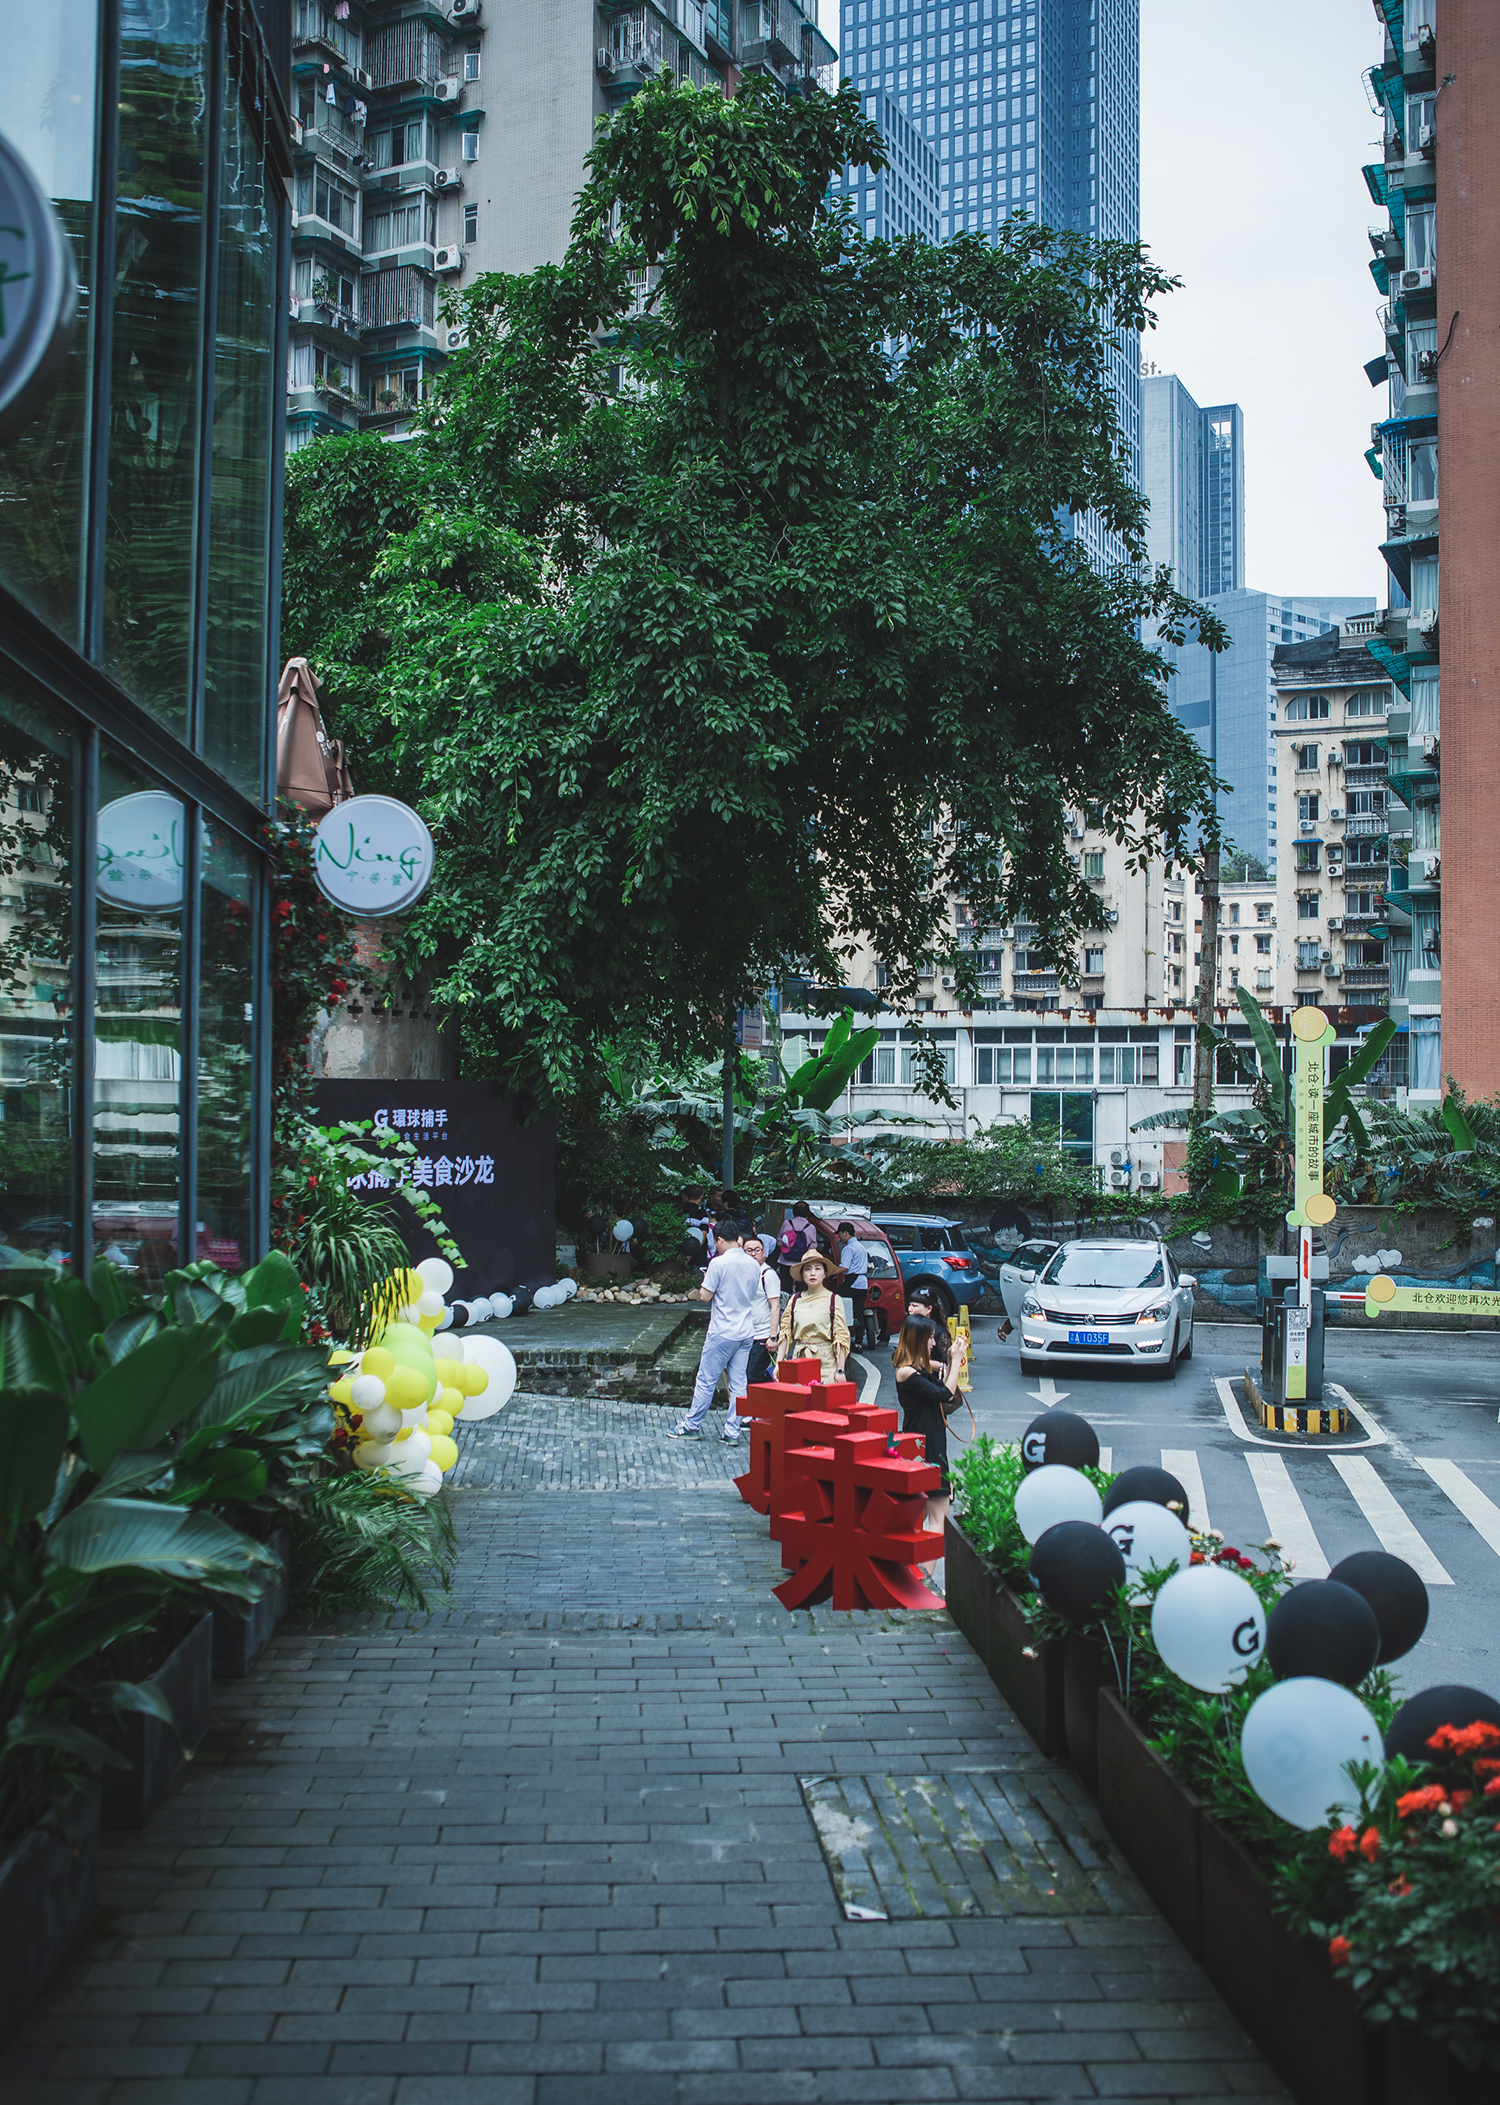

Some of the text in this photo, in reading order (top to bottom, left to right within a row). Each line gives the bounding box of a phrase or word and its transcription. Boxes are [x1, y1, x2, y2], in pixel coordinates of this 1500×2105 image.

[318, 822, 422, 881] Ning
[374, 1109, 448, 1128] G 環球捕手
[1023, 1431, 1047, 1464] G
[1231, 1617, 1260, 1657] G
